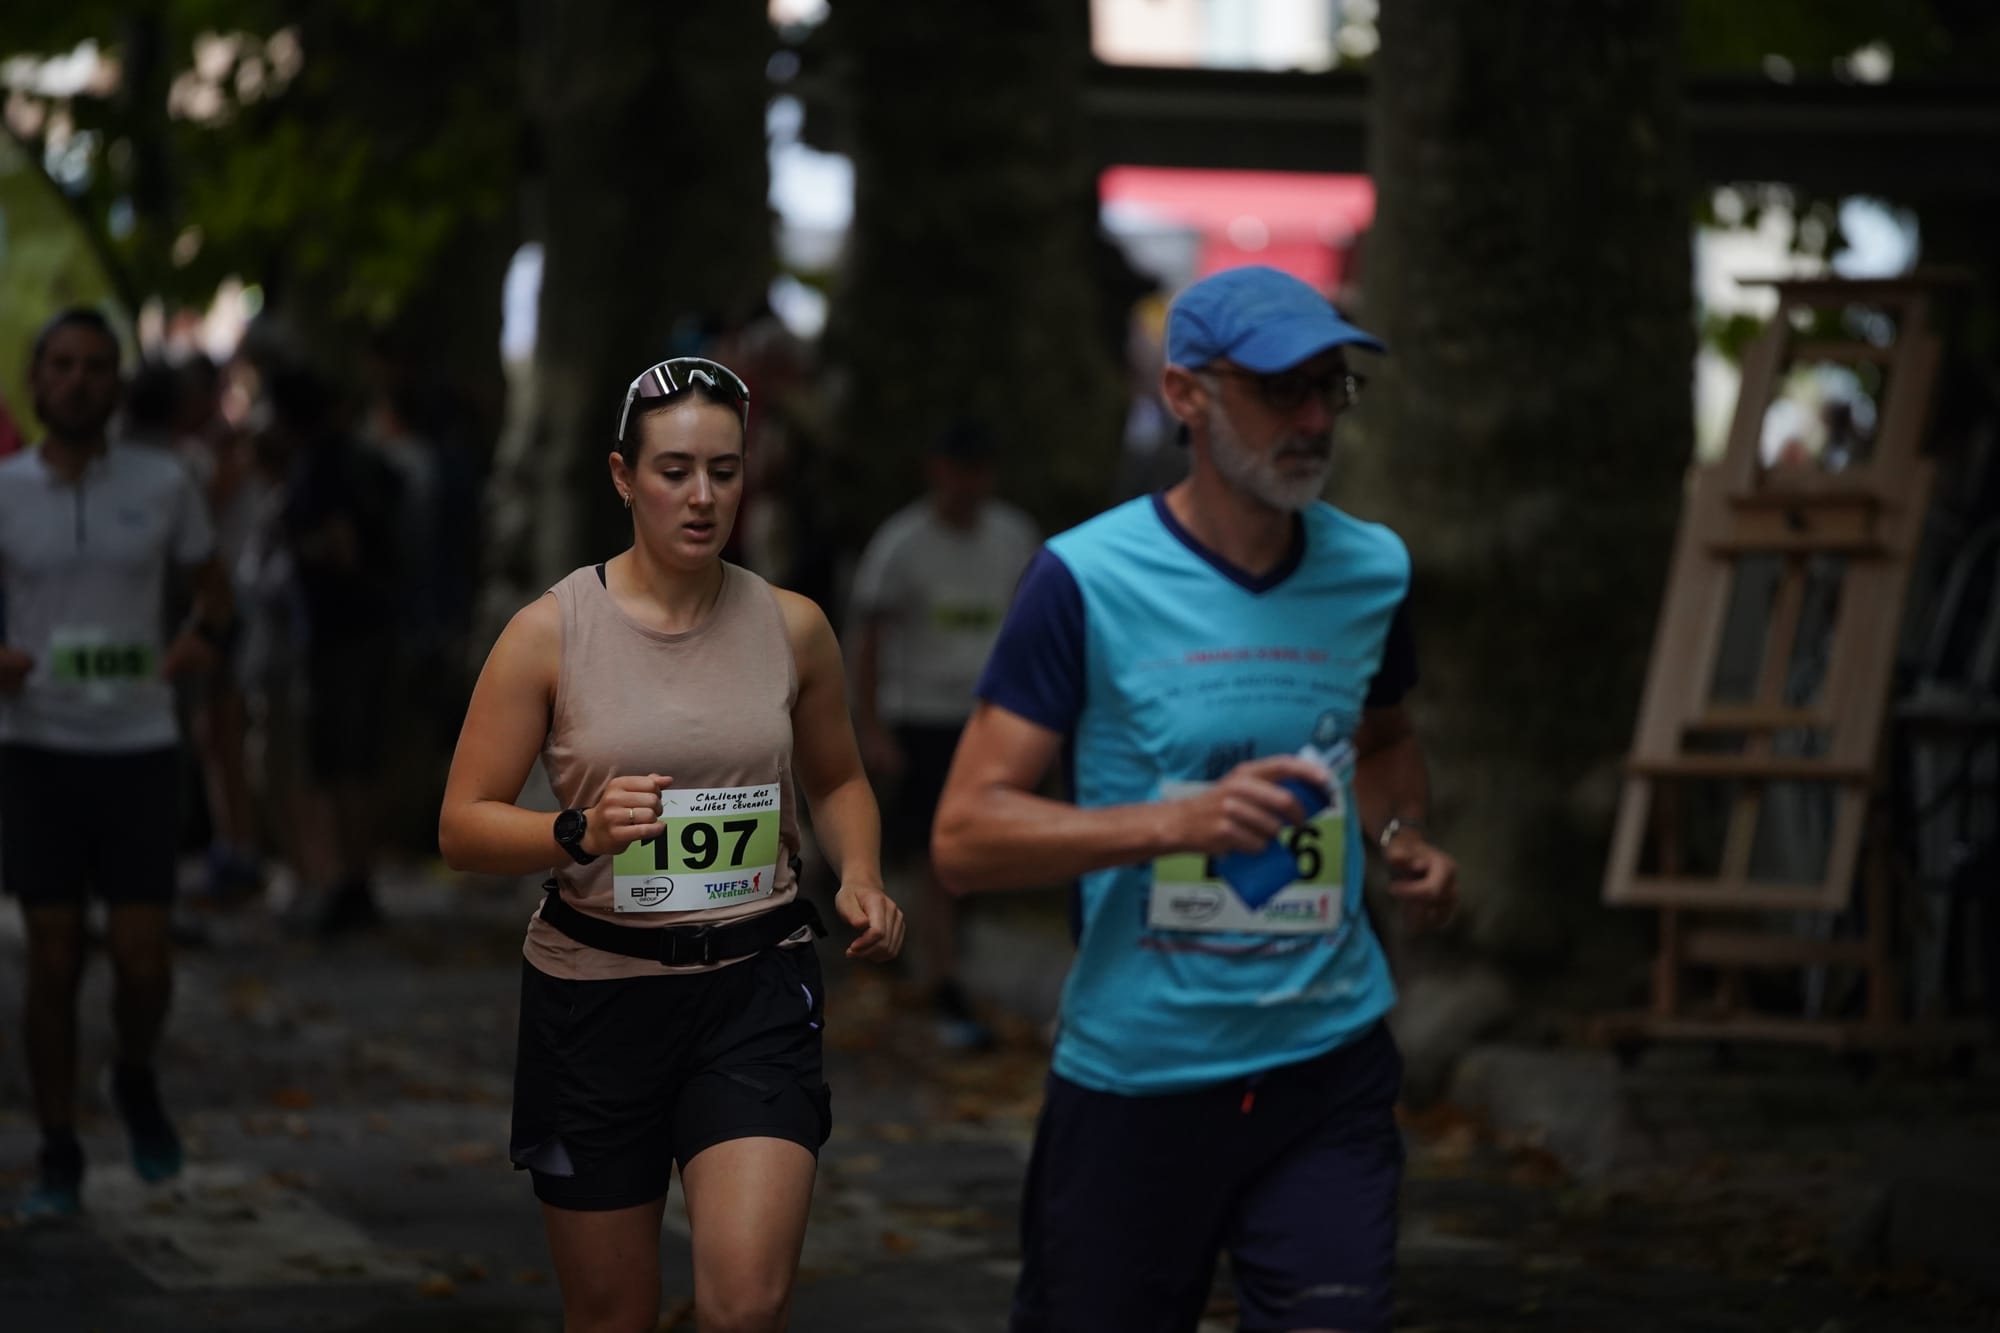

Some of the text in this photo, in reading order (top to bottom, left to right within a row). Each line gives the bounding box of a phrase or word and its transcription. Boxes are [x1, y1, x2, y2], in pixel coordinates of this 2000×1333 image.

[696, 789, 769, 803] Challenge des
[690, 799, 773, 811] vallées cévenoles
[640, 818, 759, 871] 197
[631, 887, 667, 897] BFP
[704, 879, 749, 893] TUFF'S
